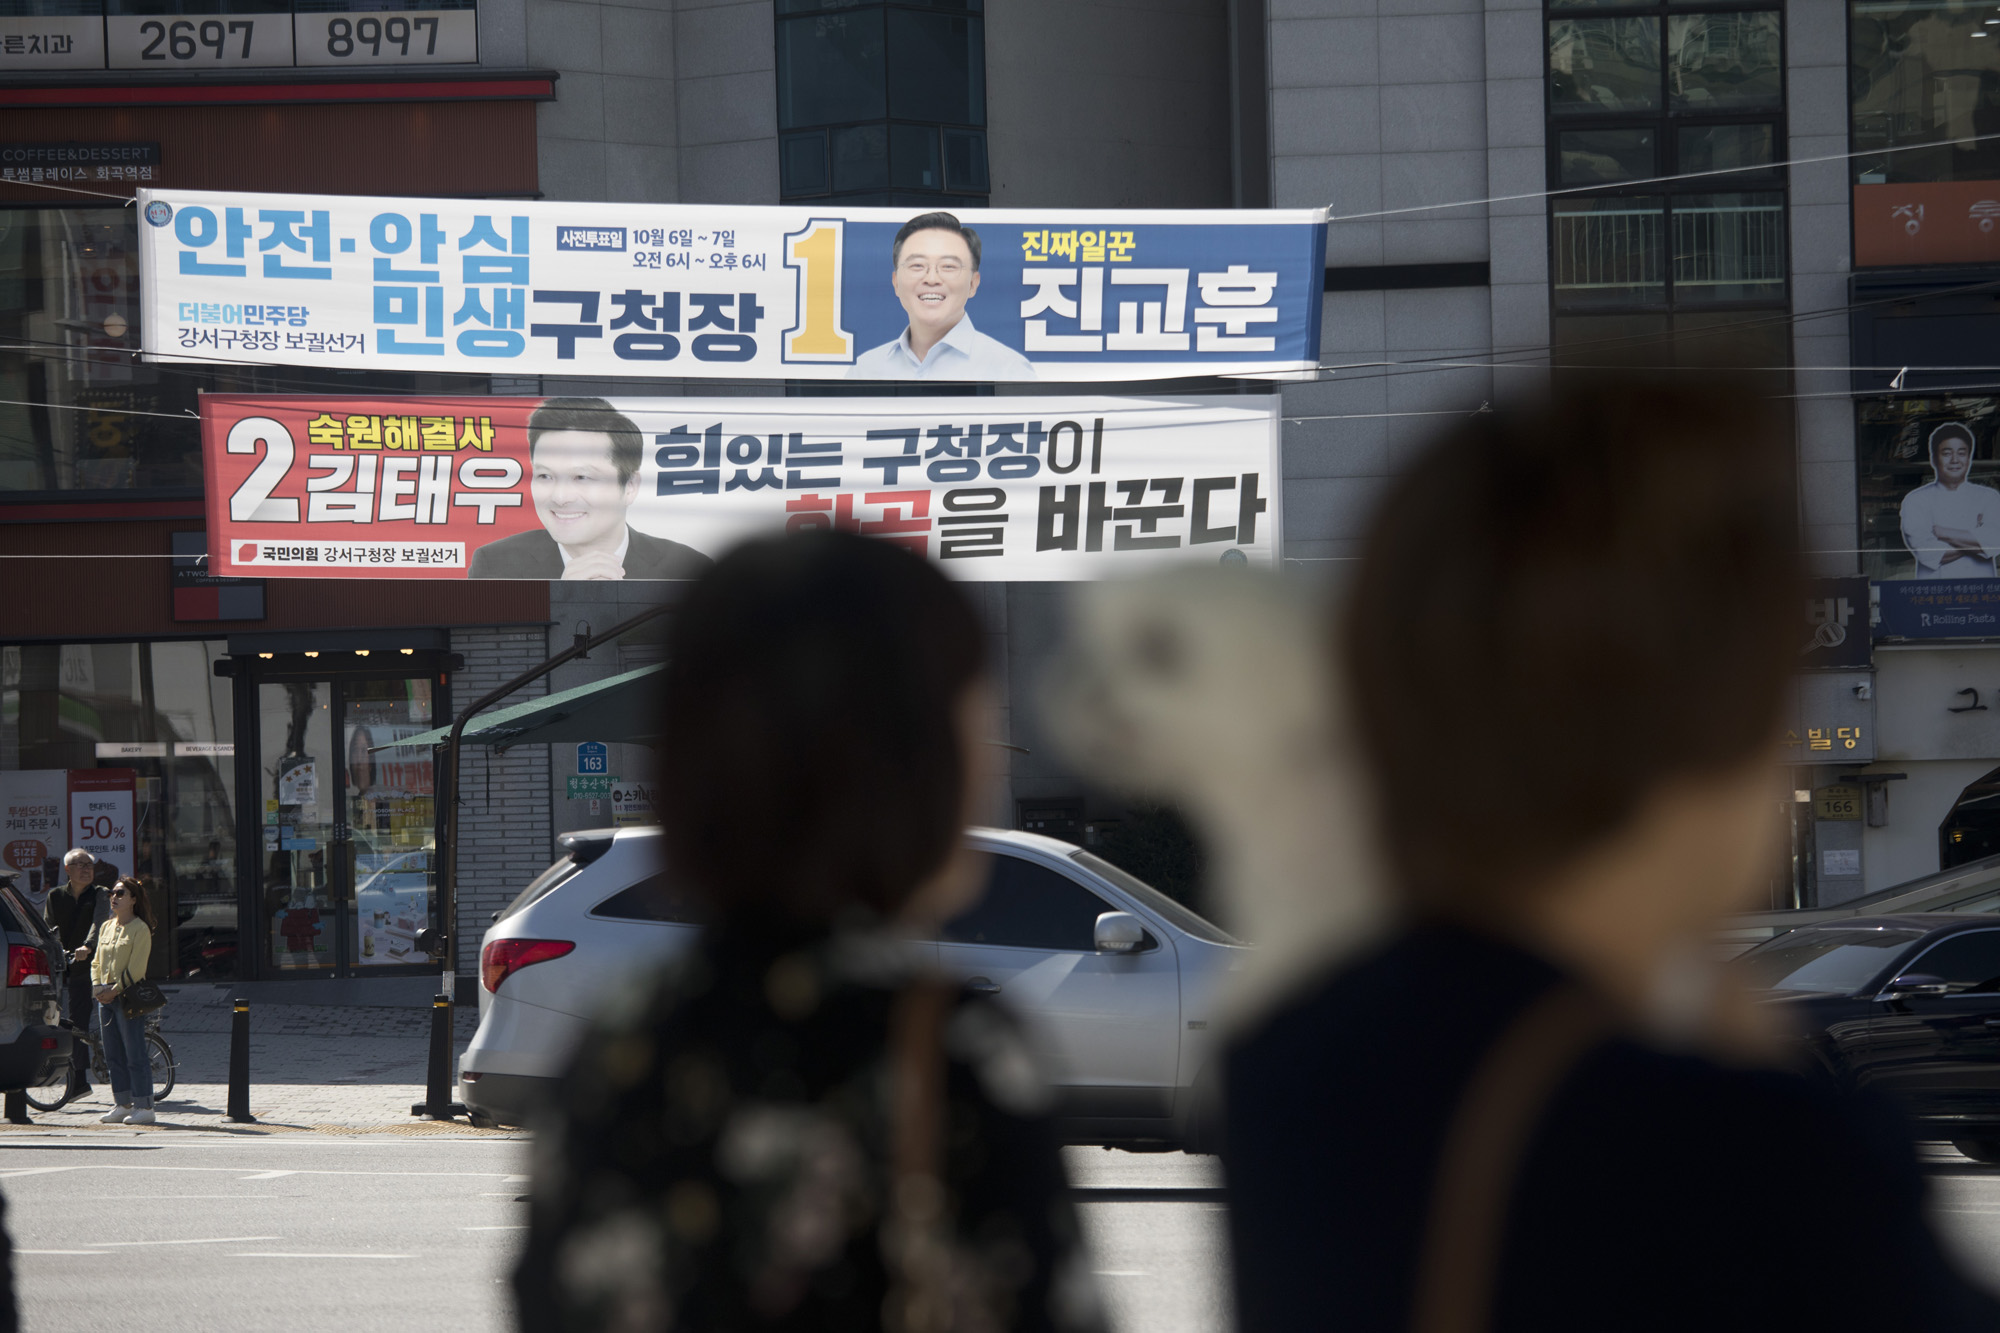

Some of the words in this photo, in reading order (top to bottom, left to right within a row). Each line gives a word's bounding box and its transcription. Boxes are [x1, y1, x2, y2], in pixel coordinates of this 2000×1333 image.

[0, 34, 74, 55] 른치과
[140, 20, 254, 61] 2697
[327, 17, 440, 58] 8997
[2, 148, 151, 162] COFFEE&DESSERT
[2, 167, 88, 182] 투썸플레이스
[96, 165, 153, 181] 화곡역점
[173, 205, 531, 285] 안전·안심
[560, 229, 623, 249] 사전투표일
[633, 229, 664, 247] 10월
[668, 229, 693, 248] 6일
[712, 230, 735, 248] 7일
[1021, 230, 1136, 262] 진짜일꾼
[632, 251, 662, 269] 오전
[666, 252, 690, 270] 6시
[709, 252, 738, 271] 오후
[742, 253, 767, 271] 6시
[781, 218, 857, 365] 1
[178, 302, 310, 328] 더불어민주당
[1020, 265, 1279, 352] 진교훈
[177, 327, 281, 353] 강서구청장
[285, 329, 366, 355] 보궐선거
[307, 412, 495, 452] 숙원해결사
[654, 421, 844, 497] 힘있는
[862, 417, 1105, 485] 구청장이
[226, 416, 301, 523] 2
[305, 453, 524, 525] 김태우
[1036, 473, 1267, 553] 바꾼다
[262, 546, 319, 562] 국민의힘
[323, 547, 397, 564] 강서구청장
[401, 546, 459, 564] 보궐선거
[1933, 614, 1966, 625] Rolling
[1968, 612, 1996, 624] Pasta
[583, 757, 602, 770] 163
[8, 805, 59, 818] 투썸오더로
[89, 802, 117, 812] 현대카드
[1825, 801, 1853, 812] 166
[6, 818, 26, 830] 커피
[28, 818, 49, 830] 주문
[51, 818, 61, 829] 시
[80, 815, 126, 840] 50%
[13, 847, 38, 857] SIZE
[111, 844, 126, 853] 사용
[16, 857, 35, 867] UP!
